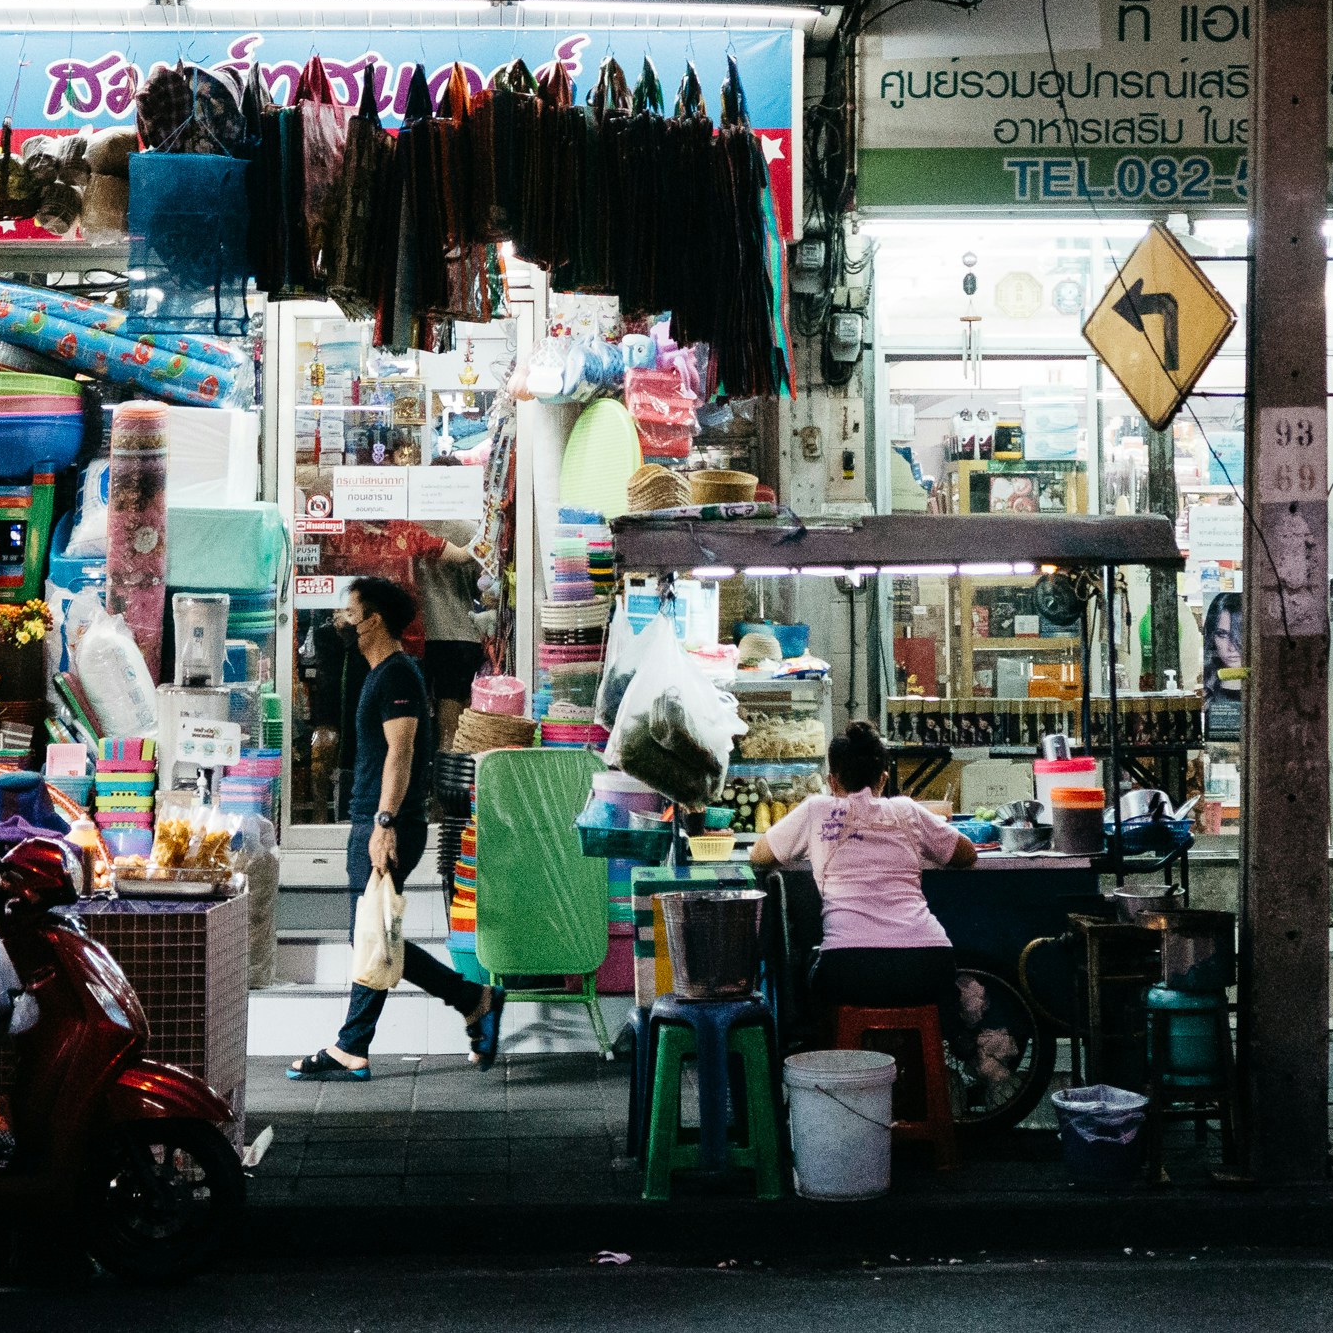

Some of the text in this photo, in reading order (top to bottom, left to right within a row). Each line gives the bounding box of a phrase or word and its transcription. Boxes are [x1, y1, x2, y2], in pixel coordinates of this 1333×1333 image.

[994, 111, 1184, 145] อาหารเสริม
[1275, 419, 1314, 447] 93
[297, 585, 333, 594] PUSH
